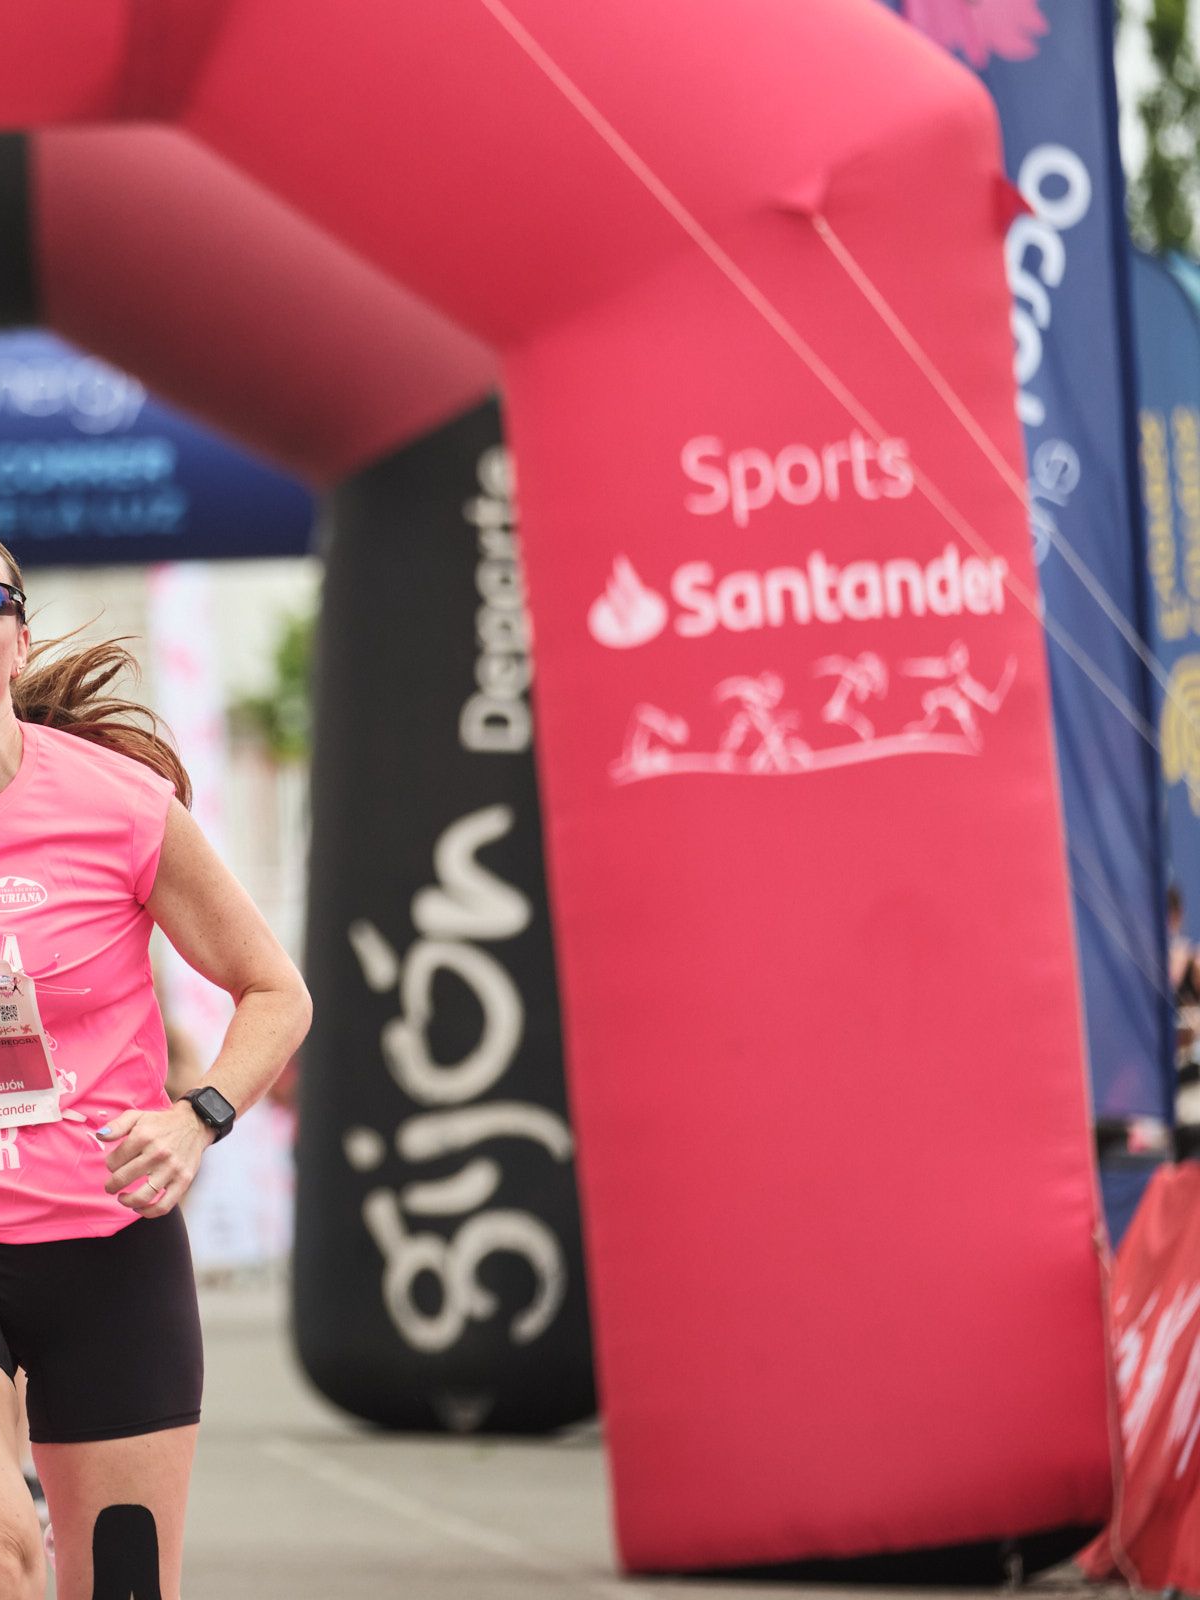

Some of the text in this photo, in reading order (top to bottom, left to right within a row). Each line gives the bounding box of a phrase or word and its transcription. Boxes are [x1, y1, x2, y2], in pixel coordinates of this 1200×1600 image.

[680, 429, 914, 528] Sports
[671, 543, 1007, 638] Santander
[345, 803, 573, 1353] gijón
